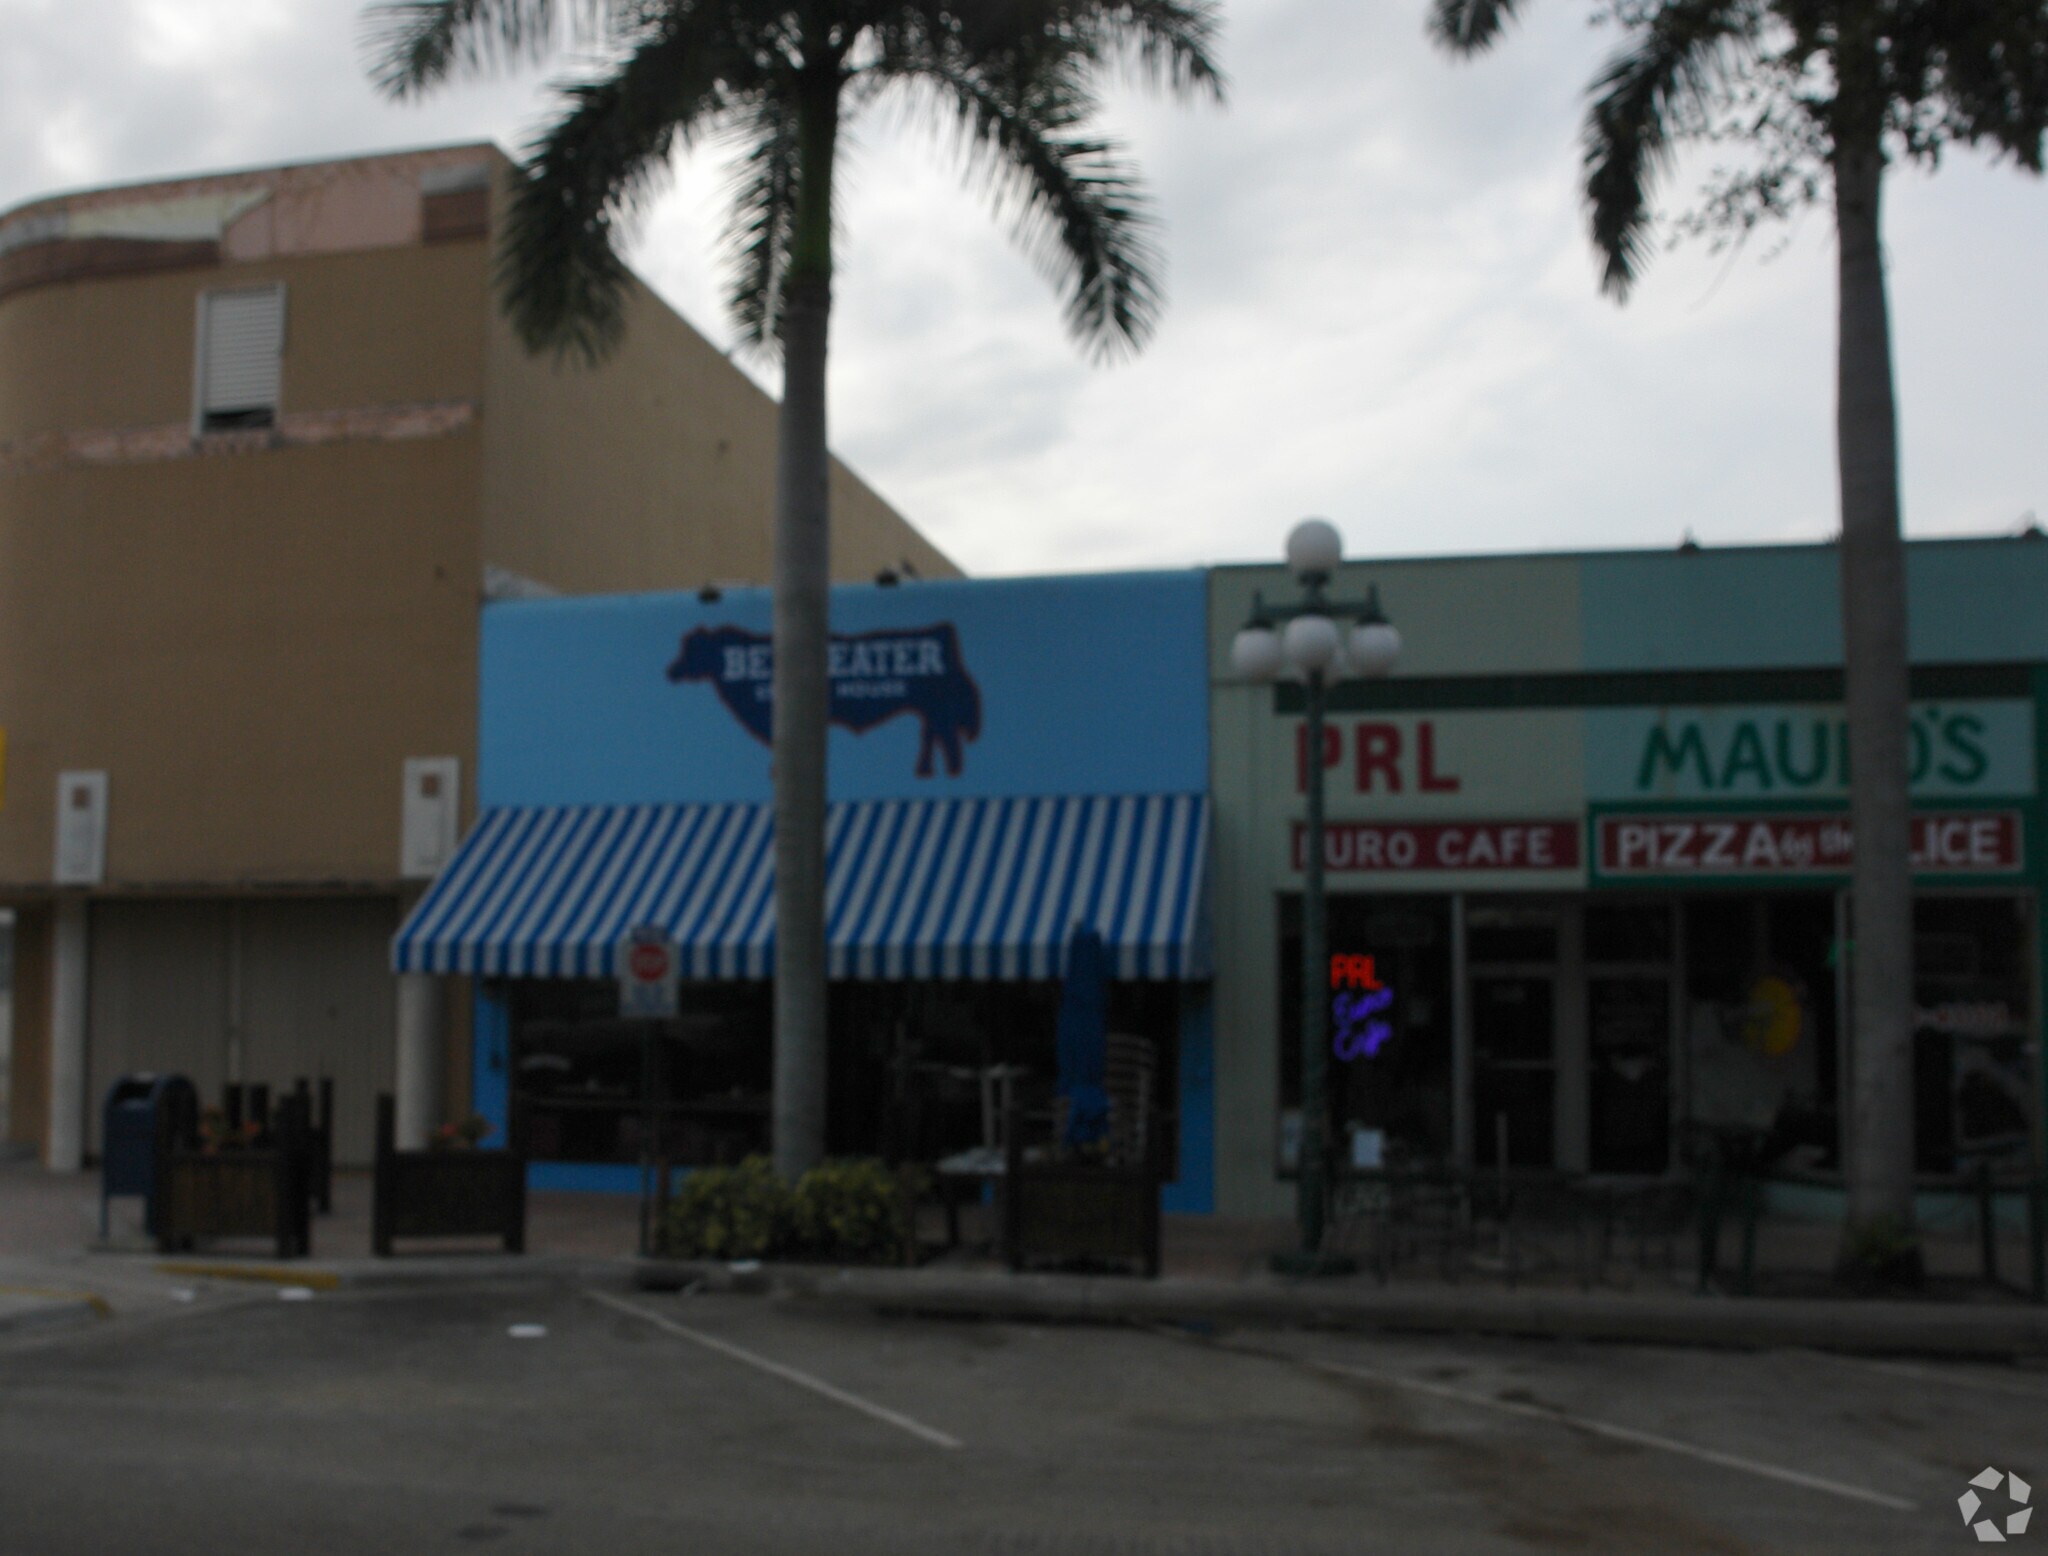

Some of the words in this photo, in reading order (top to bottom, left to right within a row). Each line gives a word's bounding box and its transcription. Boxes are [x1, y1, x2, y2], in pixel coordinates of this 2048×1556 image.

[724, 640, 944, 679] BEEATER
[1296, 720, 1460, 793] PRL
[1437, 827, 1554, 865] CAFE
[1618, 823, 1779, 865] PIZZA
